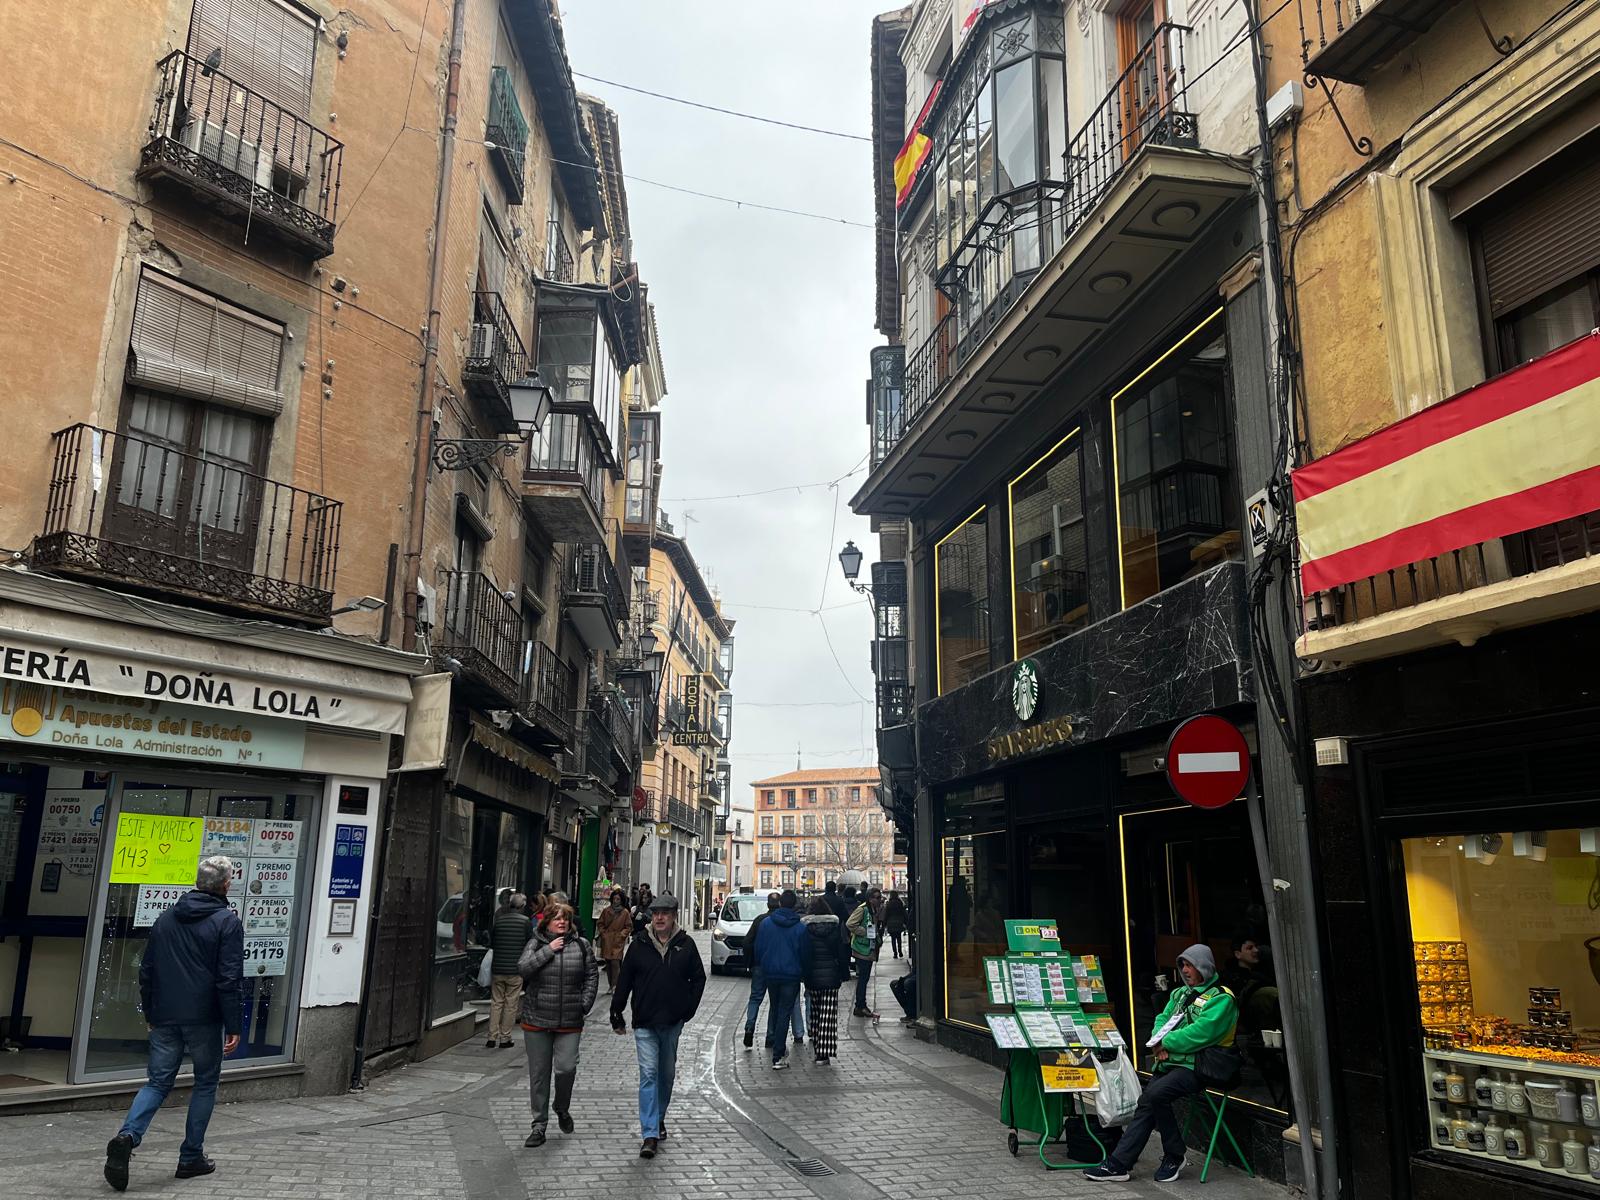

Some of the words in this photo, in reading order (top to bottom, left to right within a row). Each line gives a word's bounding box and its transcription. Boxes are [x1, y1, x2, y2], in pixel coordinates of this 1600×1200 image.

[0, 646, 91, 686] ERÍA
[686, 676, 697, 733] HOSTAL
[60, 705, 153, 734] Apuestas
[158, 717, 186, 736] del
[190, 723, 253, 744] Estado
[674, 733, 709, 745] CENTRO
[987, 714, 1073, 761] STARBUCKS
[51, 730, 89, 746] Doña
[95, 733, 124, 749] Lola
[133, 737, 223, 759] Administración
[257, 751, 263, 762] 1
[49, 805, 81, 815] 00750
[118, 817, 146, 839] ESTE
[150, 821, 195, 843] MARTES
[207, 820, 251, 833] 02184
[41, 836, 66, 844] 57421
[218, 833, 248, 842] Premio
[260, 830, 294, 841] 00750
[118, 846, 149, 869] 143
[257, 871, 288, 881] 00580
[249, 906, 289, 916] 20140
[253, 940, 283, 948] PREMIO
[243, 948, 284, 959] 91179
